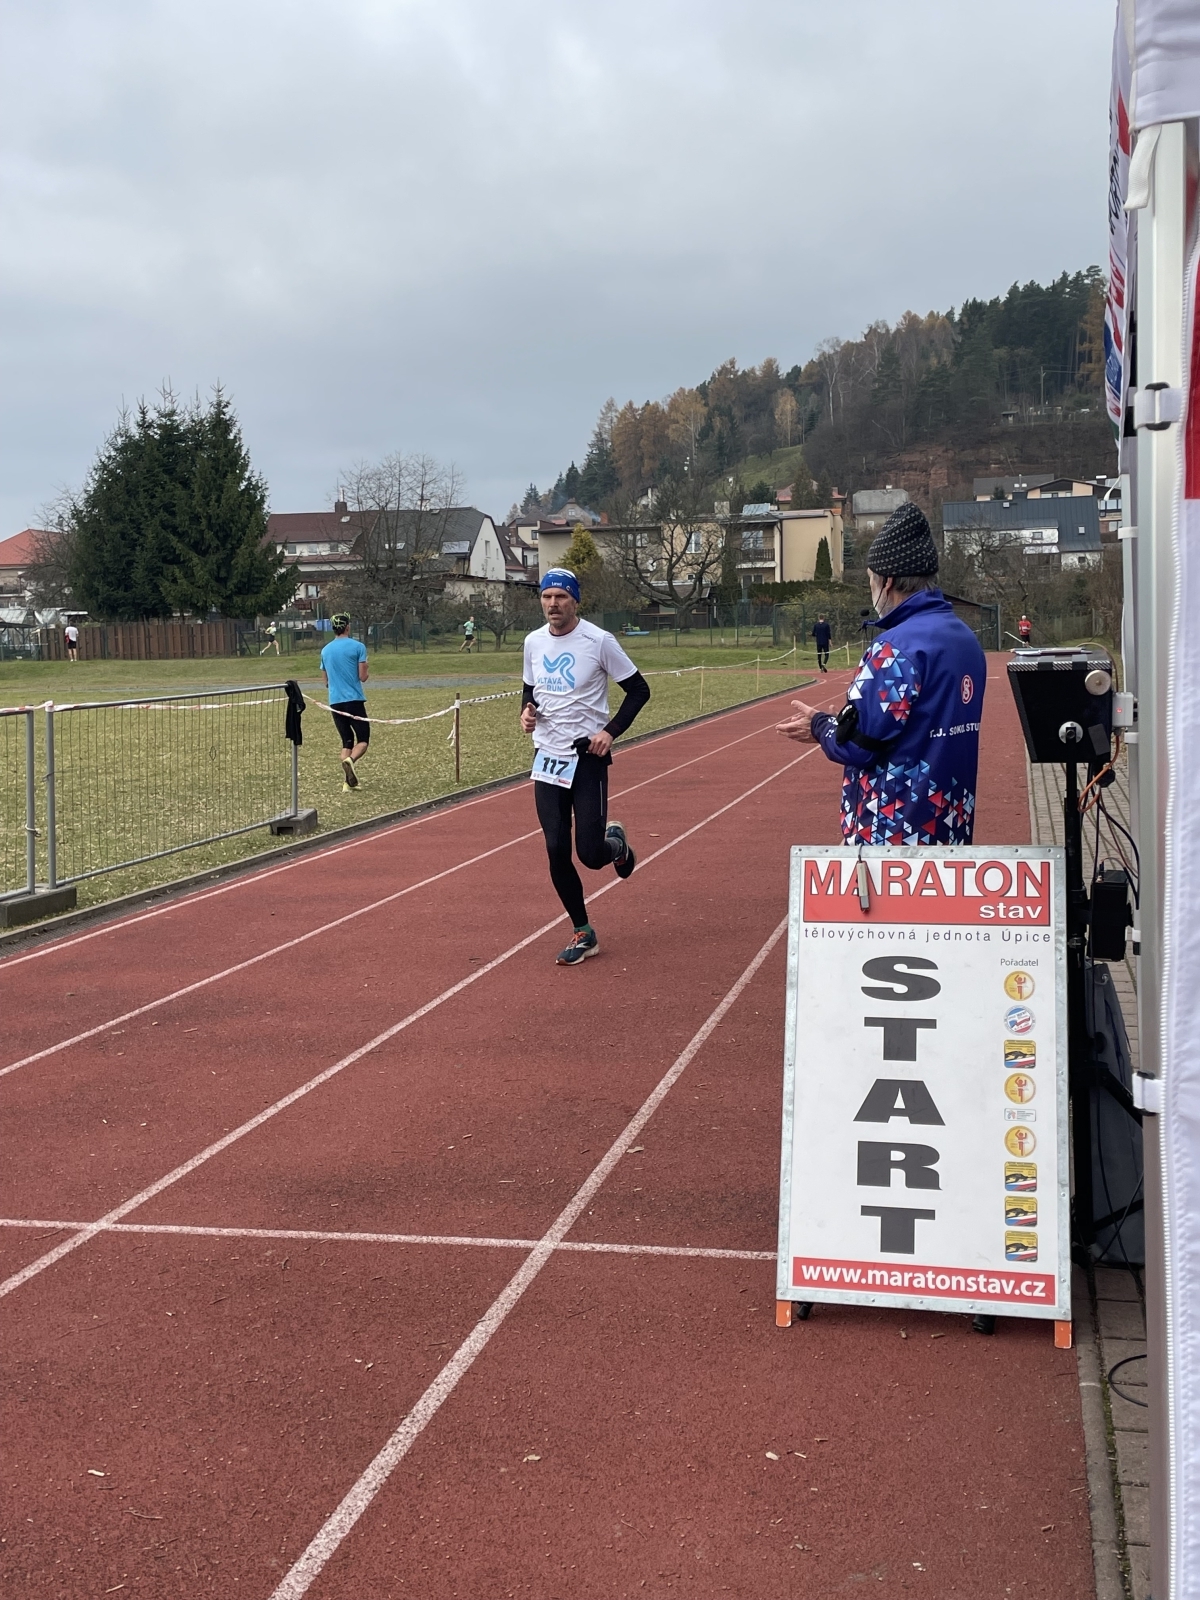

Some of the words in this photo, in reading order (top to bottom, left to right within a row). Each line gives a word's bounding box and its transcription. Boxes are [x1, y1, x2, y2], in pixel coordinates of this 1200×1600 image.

[542, 757, 570, 776] 117
[804, 860, 1050, 898] MARATON
[979, 902, 1043, 919] stav
[804, 927, 917, 942] tělovýchovná
[925, 929, 991, 944] jednota
[1001, 929, 1052, 945] Úpice
[1000, 958, 1039, 967] Pořadatel
[852, 955, 946, 1255] START
[801, 1265, 1046, 1297] www.maratonstav.cz
